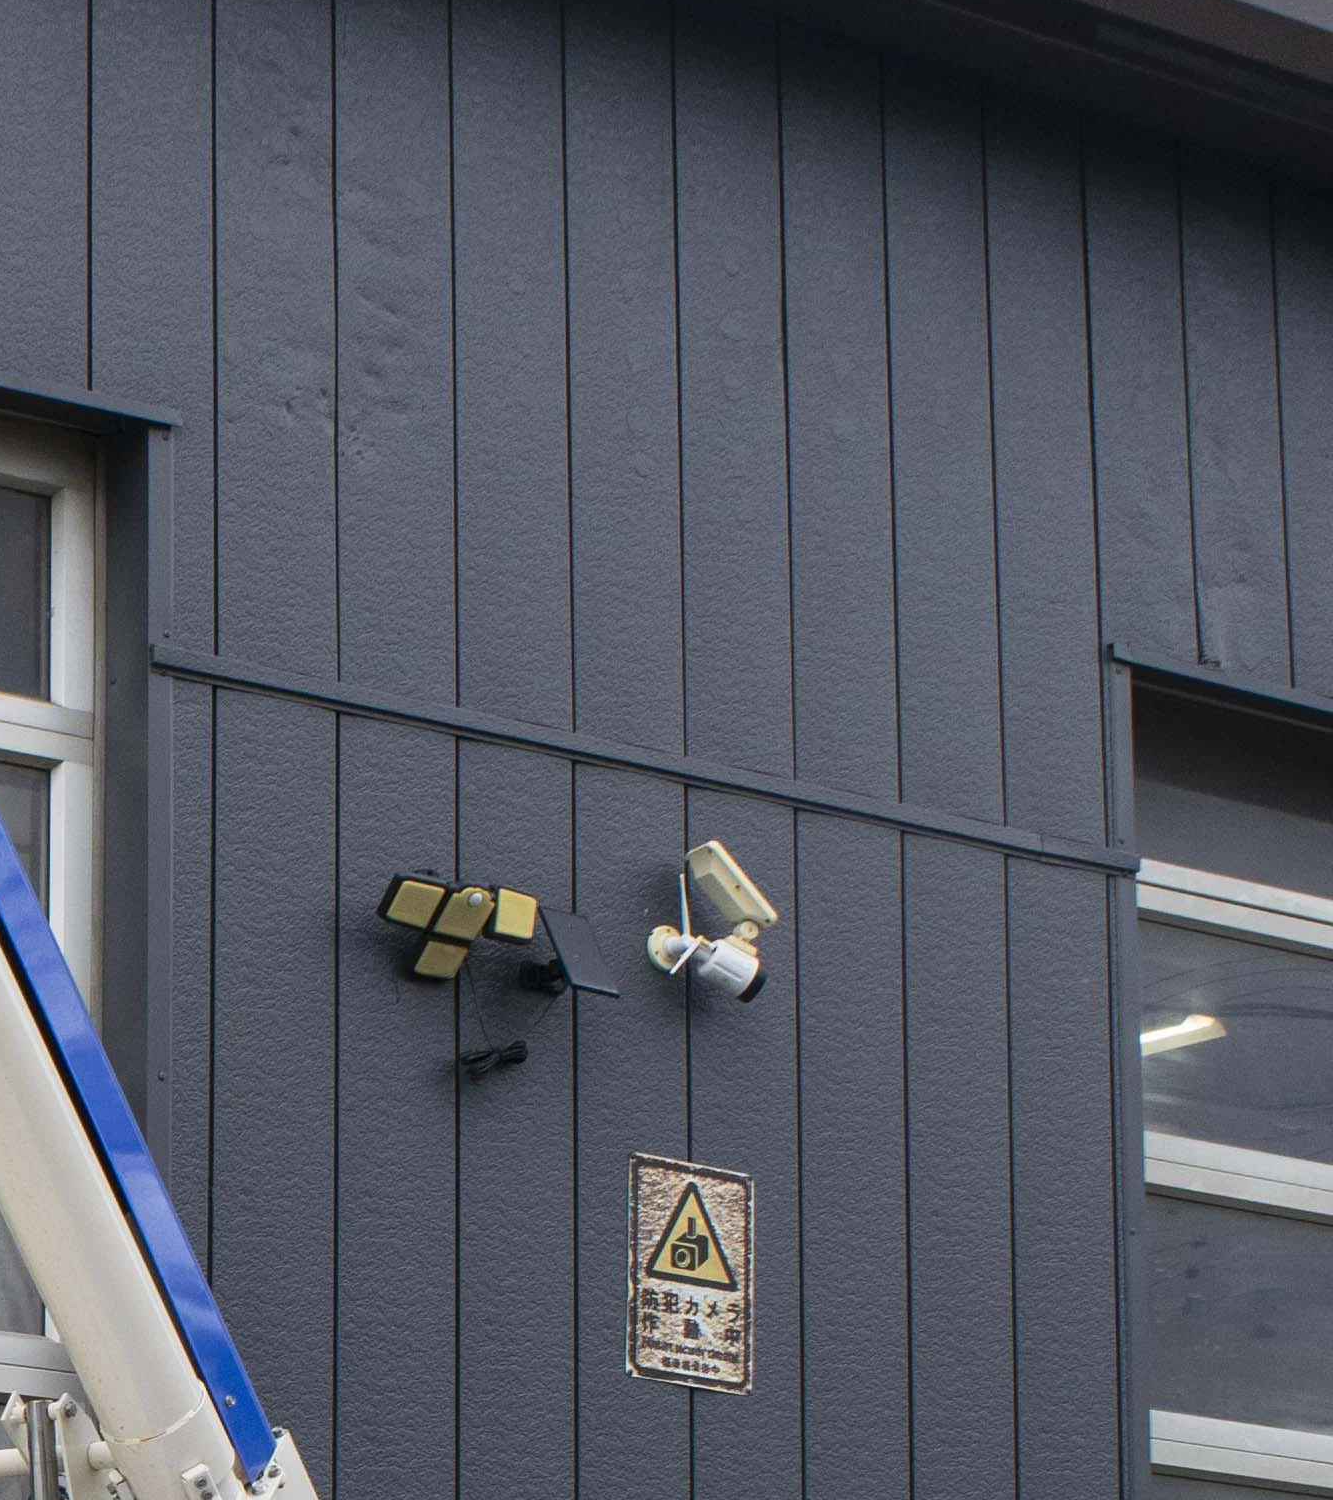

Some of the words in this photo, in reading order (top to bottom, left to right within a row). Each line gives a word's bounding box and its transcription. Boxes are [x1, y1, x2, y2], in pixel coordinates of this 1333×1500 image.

[641, 1288, 742, 1322] 防犯カメラ
